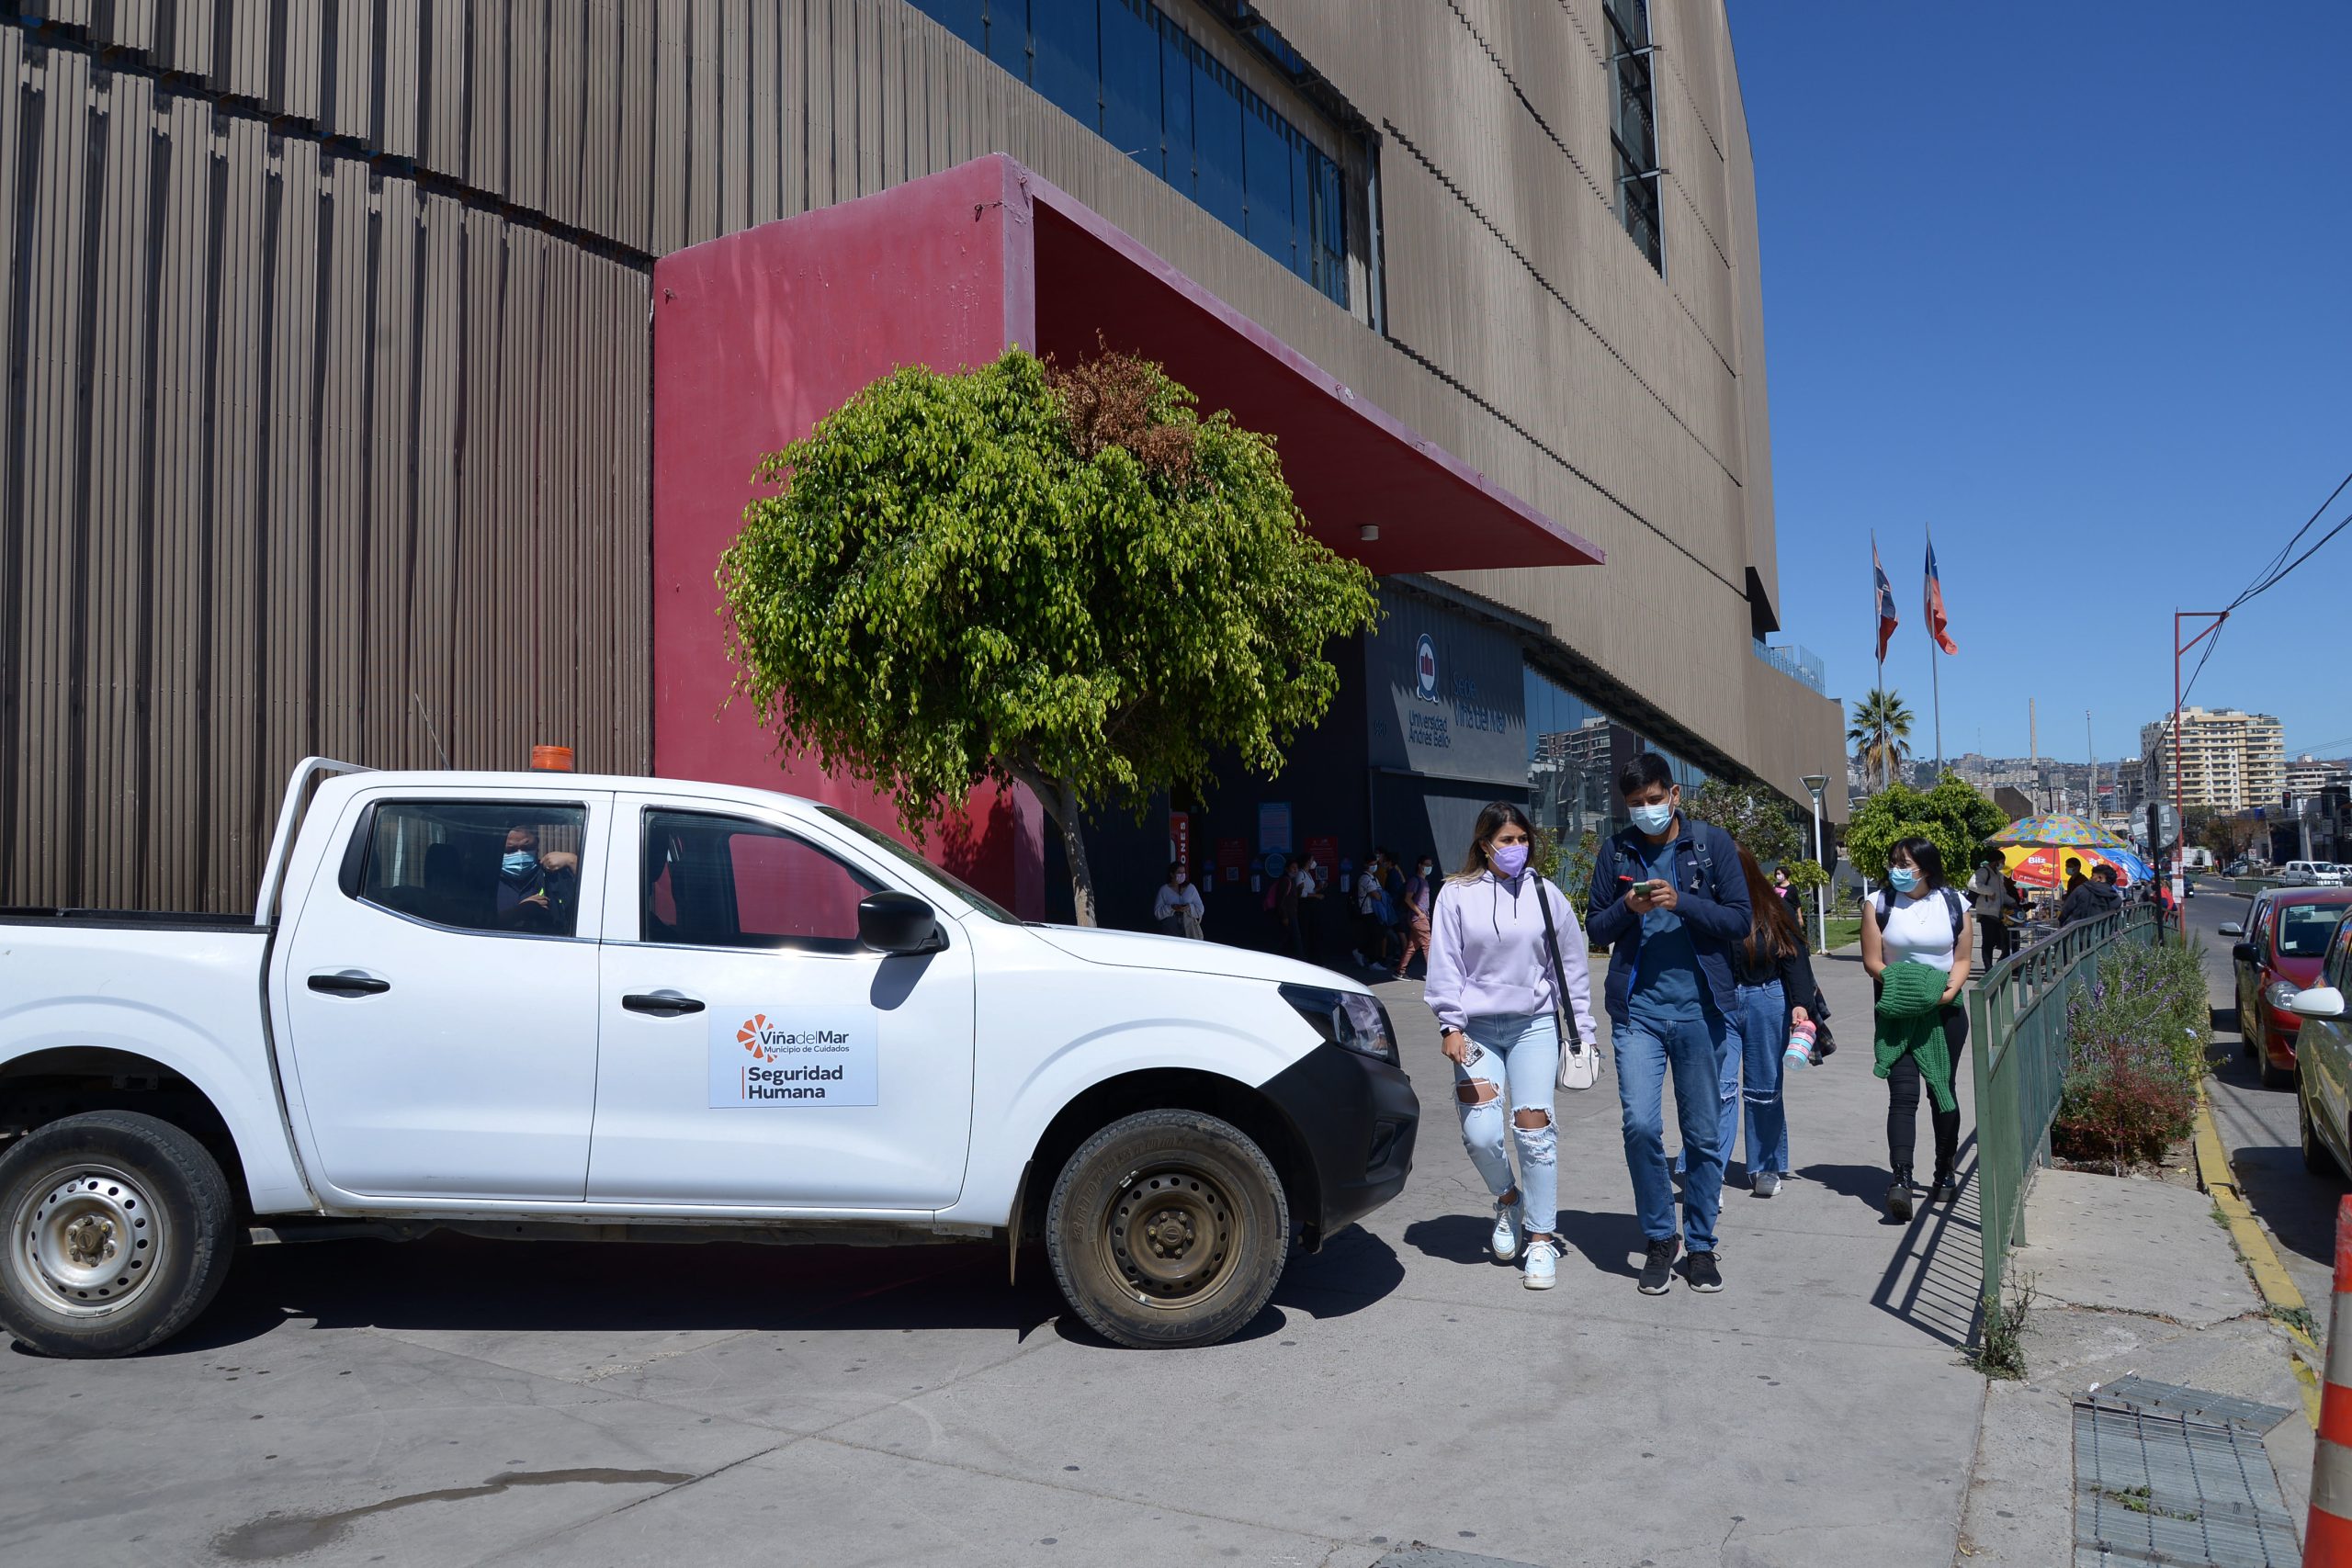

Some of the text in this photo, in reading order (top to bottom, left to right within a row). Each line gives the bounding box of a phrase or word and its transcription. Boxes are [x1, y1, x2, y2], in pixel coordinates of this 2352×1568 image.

[1453, 671, 1476, 698] Sede
[1408, 709, 1447, 732] Universidad
[760, 1030, 850, 1044] ViñadelMar
[763, 1045, 800, 1055] Municipio
[748, 1065, 843, 1086] Seguridad
[748, 1085, 826, 1100] Humana
